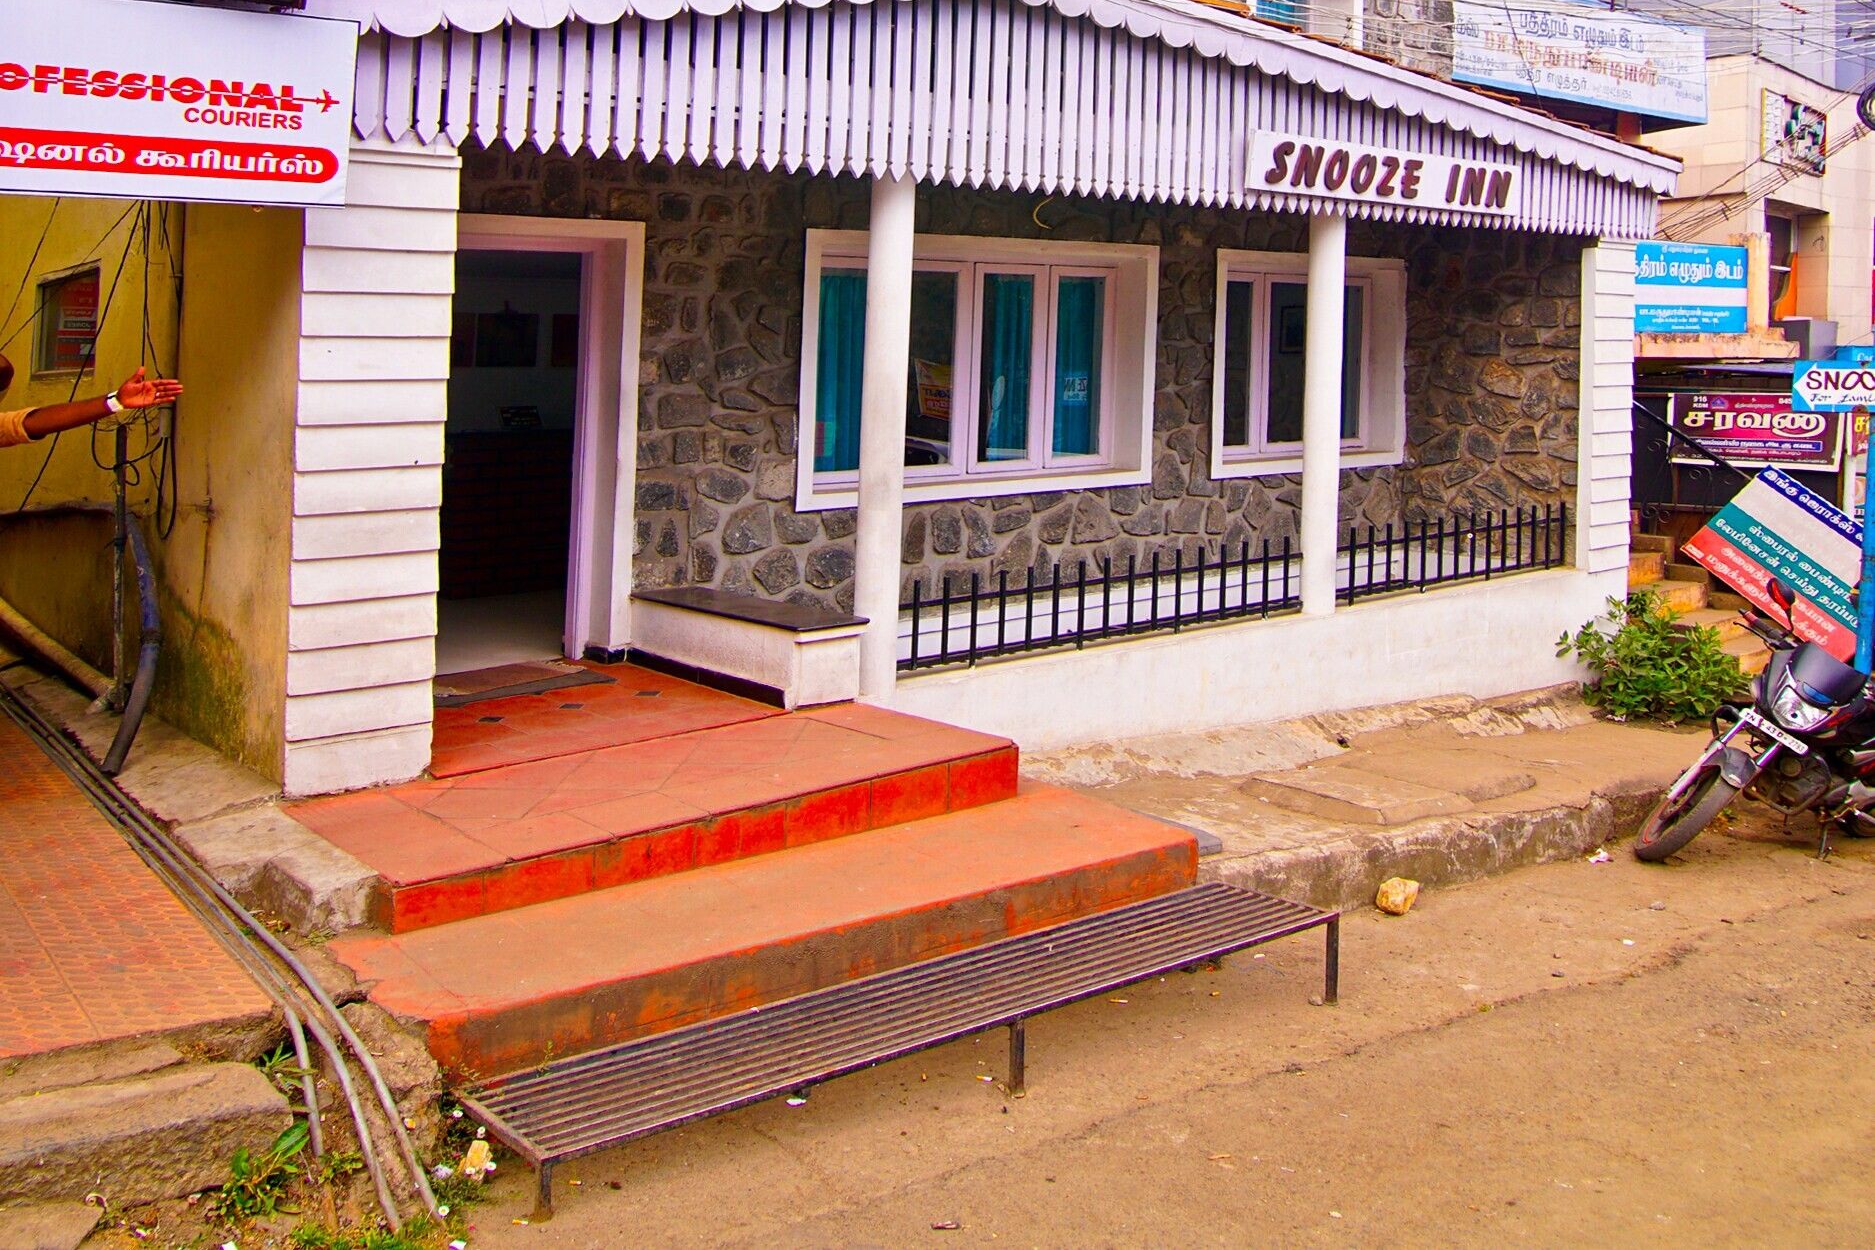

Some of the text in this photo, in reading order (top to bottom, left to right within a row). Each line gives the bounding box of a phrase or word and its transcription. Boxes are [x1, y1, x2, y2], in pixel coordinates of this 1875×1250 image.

[184, 107, 303, 131] COURIERS
[1264, 141, 1513, 208] SNOOZE INN
